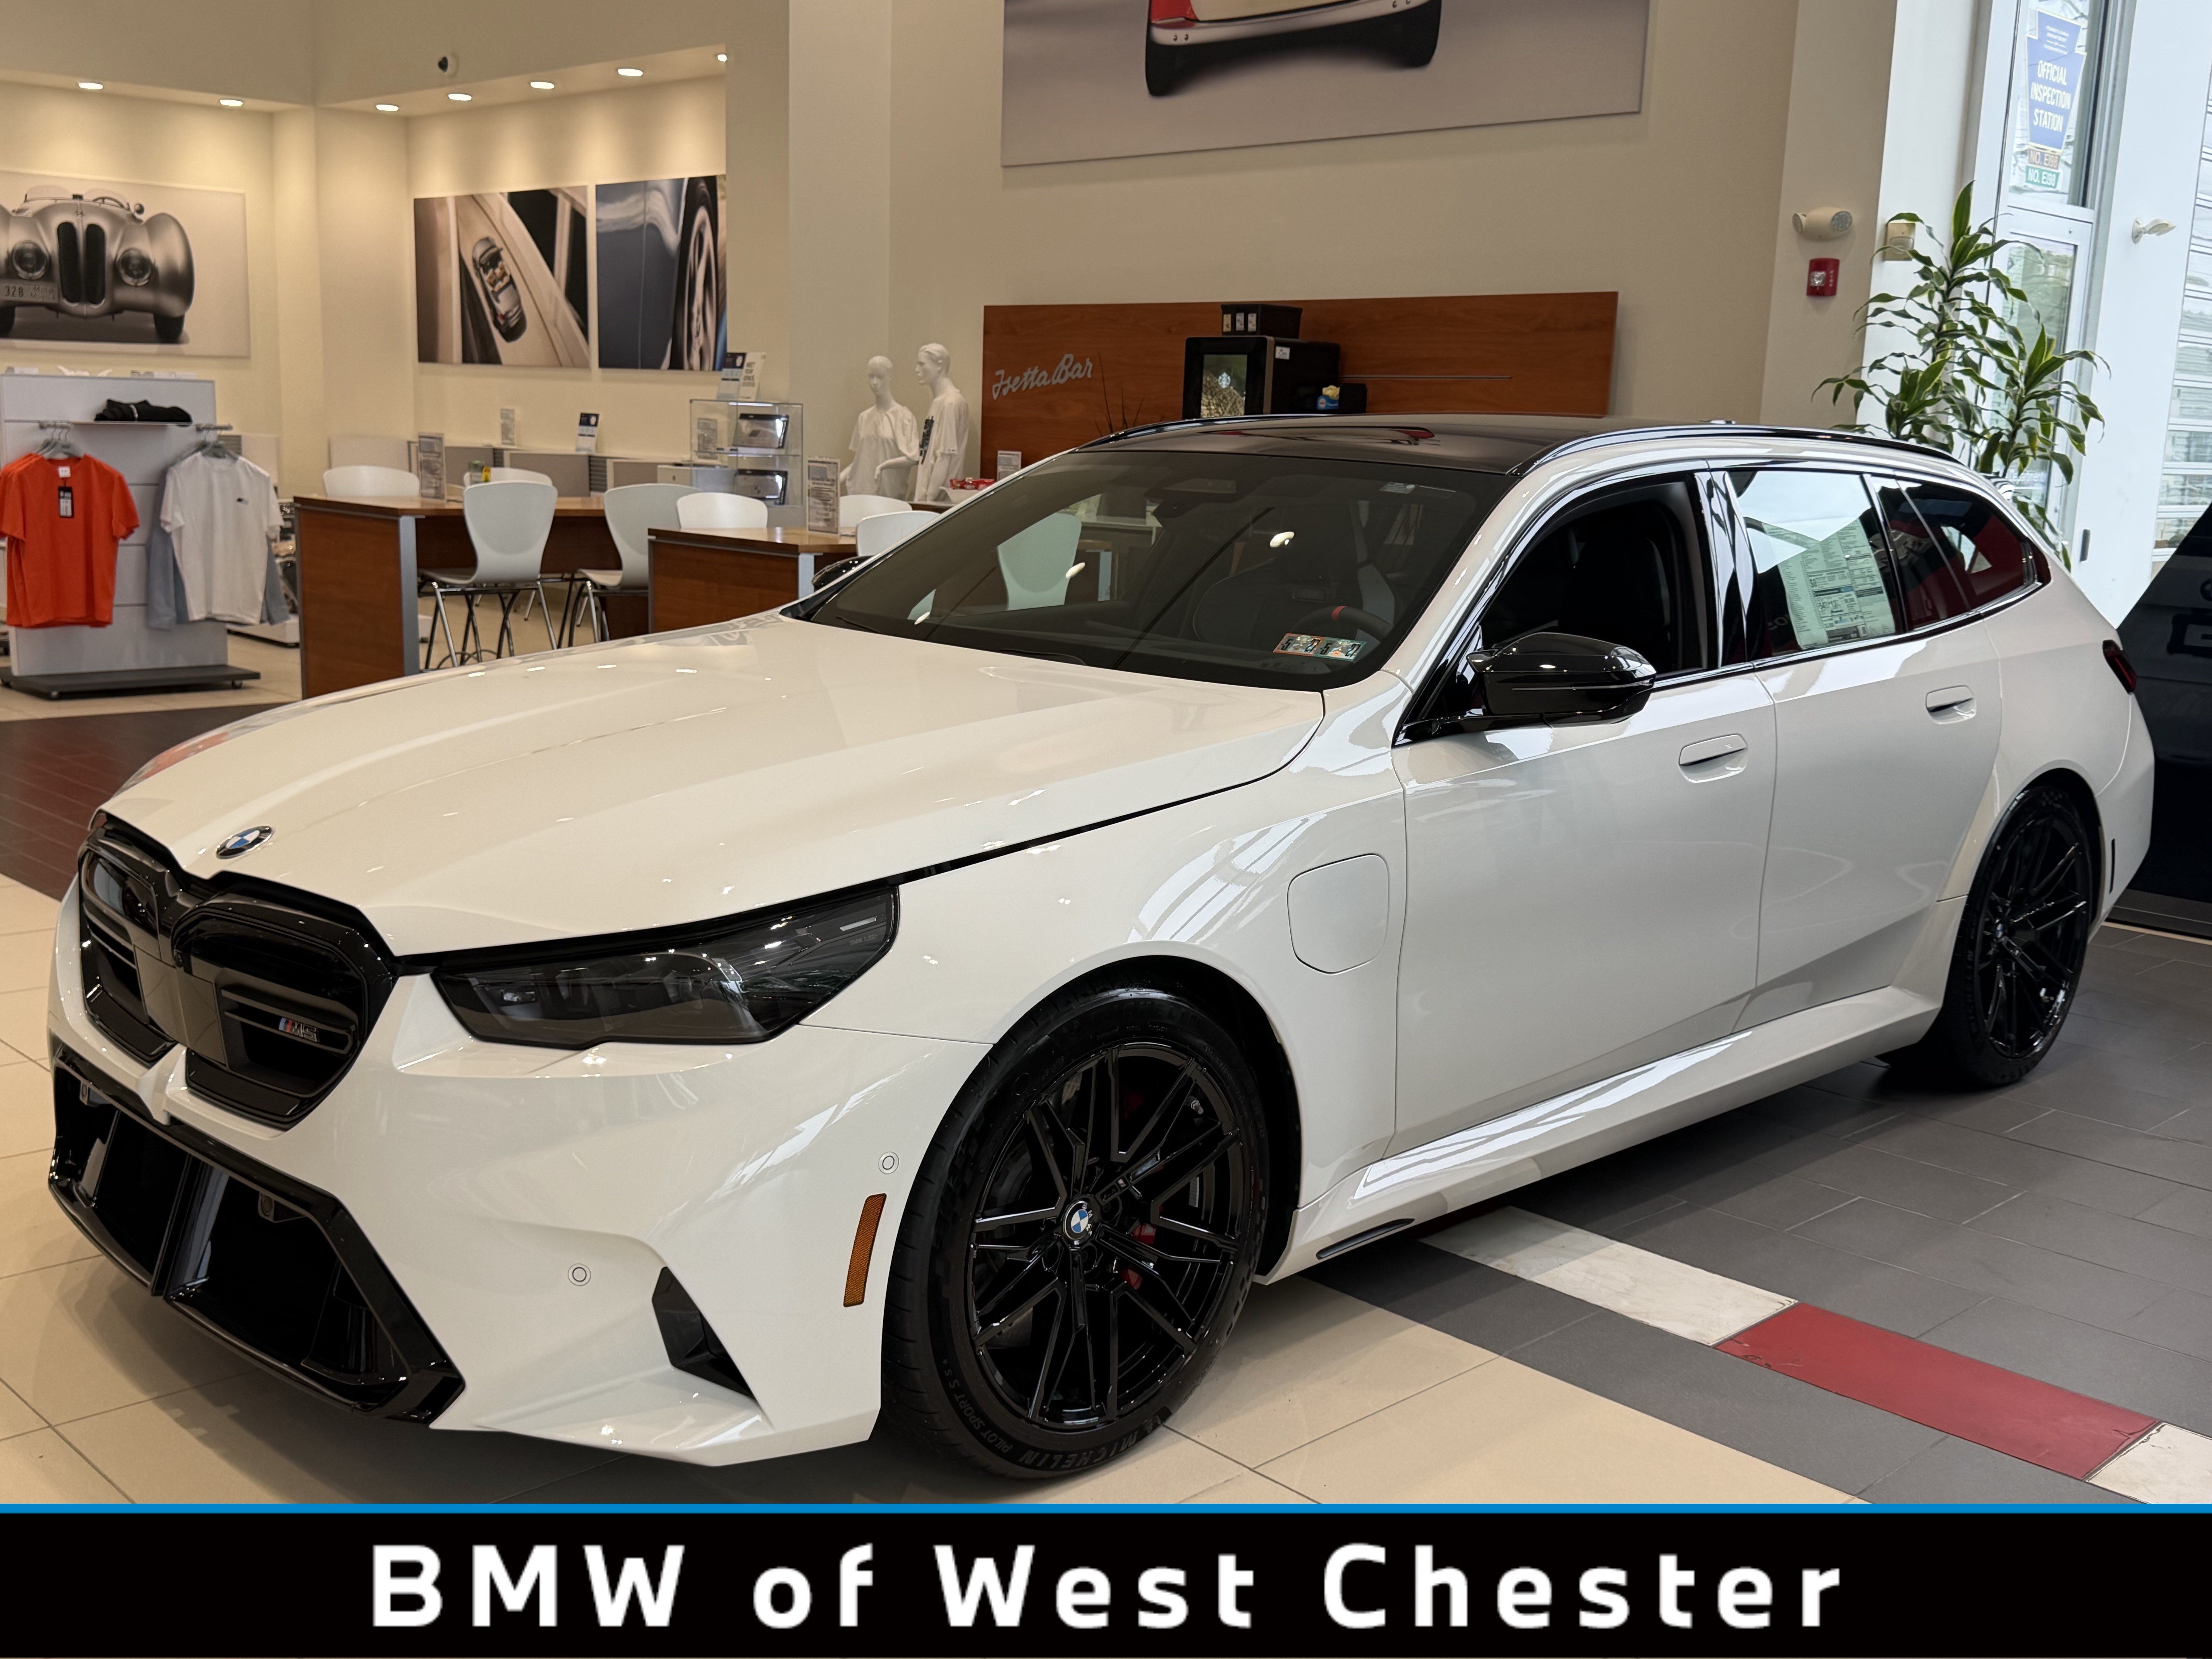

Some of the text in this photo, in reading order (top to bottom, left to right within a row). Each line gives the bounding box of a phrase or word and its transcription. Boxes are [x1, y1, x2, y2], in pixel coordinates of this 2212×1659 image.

[2037, 60, 2067, 86] OFFICIAL
[2030, 82, 2071, 110] INSPECTION
[2033, 108, 2064, 132] STATION
[2028, 168, 2040, 182] NO.
[4, 285, 24, 297] 328
[992, 353, 1093, 400] Isetta Bar
[953, 1393, 986, 1430] SPORT
[980, 1429, 1014, 1454] PILOT
[1018, 1430, 1139, 1469] MICHELIN
